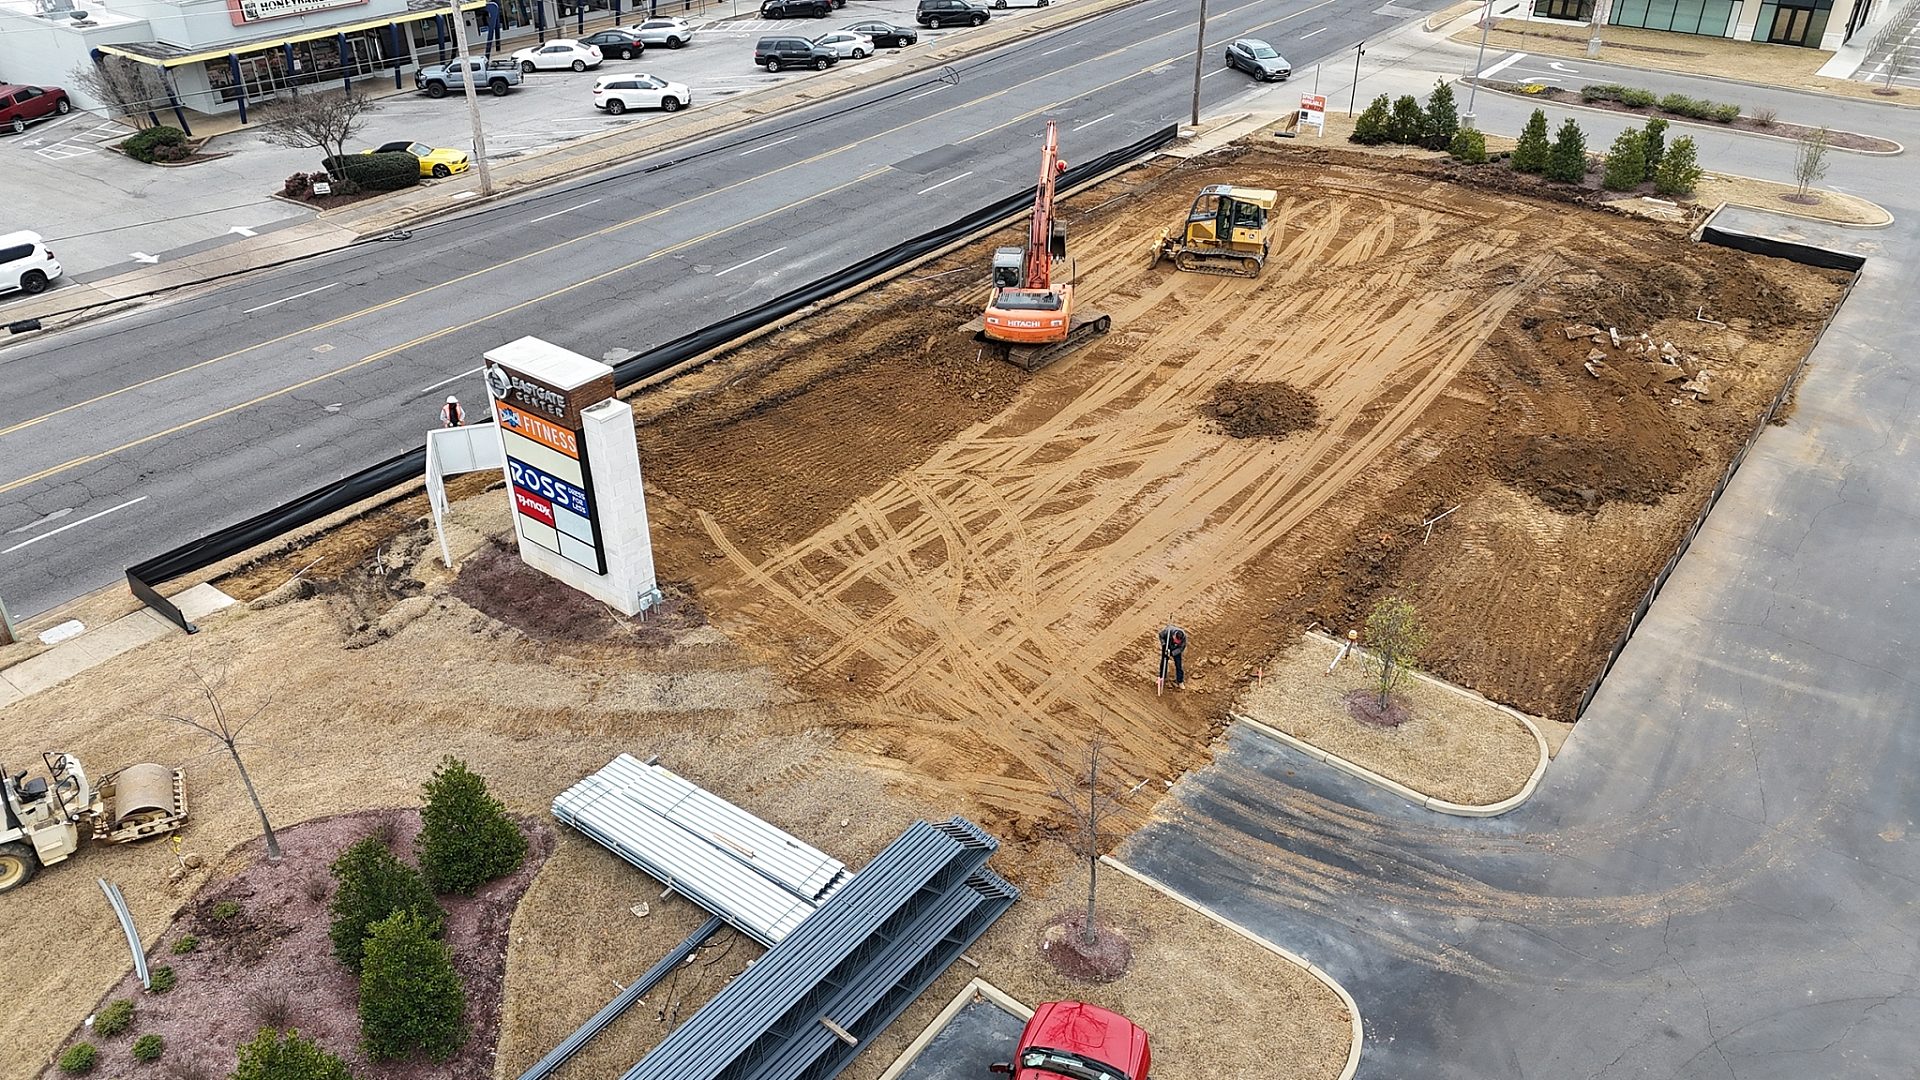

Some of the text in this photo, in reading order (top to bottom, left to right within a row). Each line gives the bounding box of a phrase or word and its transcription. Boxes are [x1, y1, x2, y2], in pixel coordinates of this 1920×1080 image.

[511, 376, 566, 408] EASTGATE
[516, 392, 564, 418] CENTER
[523, 415, 577, 452] FITNESS
[509, 461, 569, 504] ROSS
[572, 496, 584, 506] FOR
